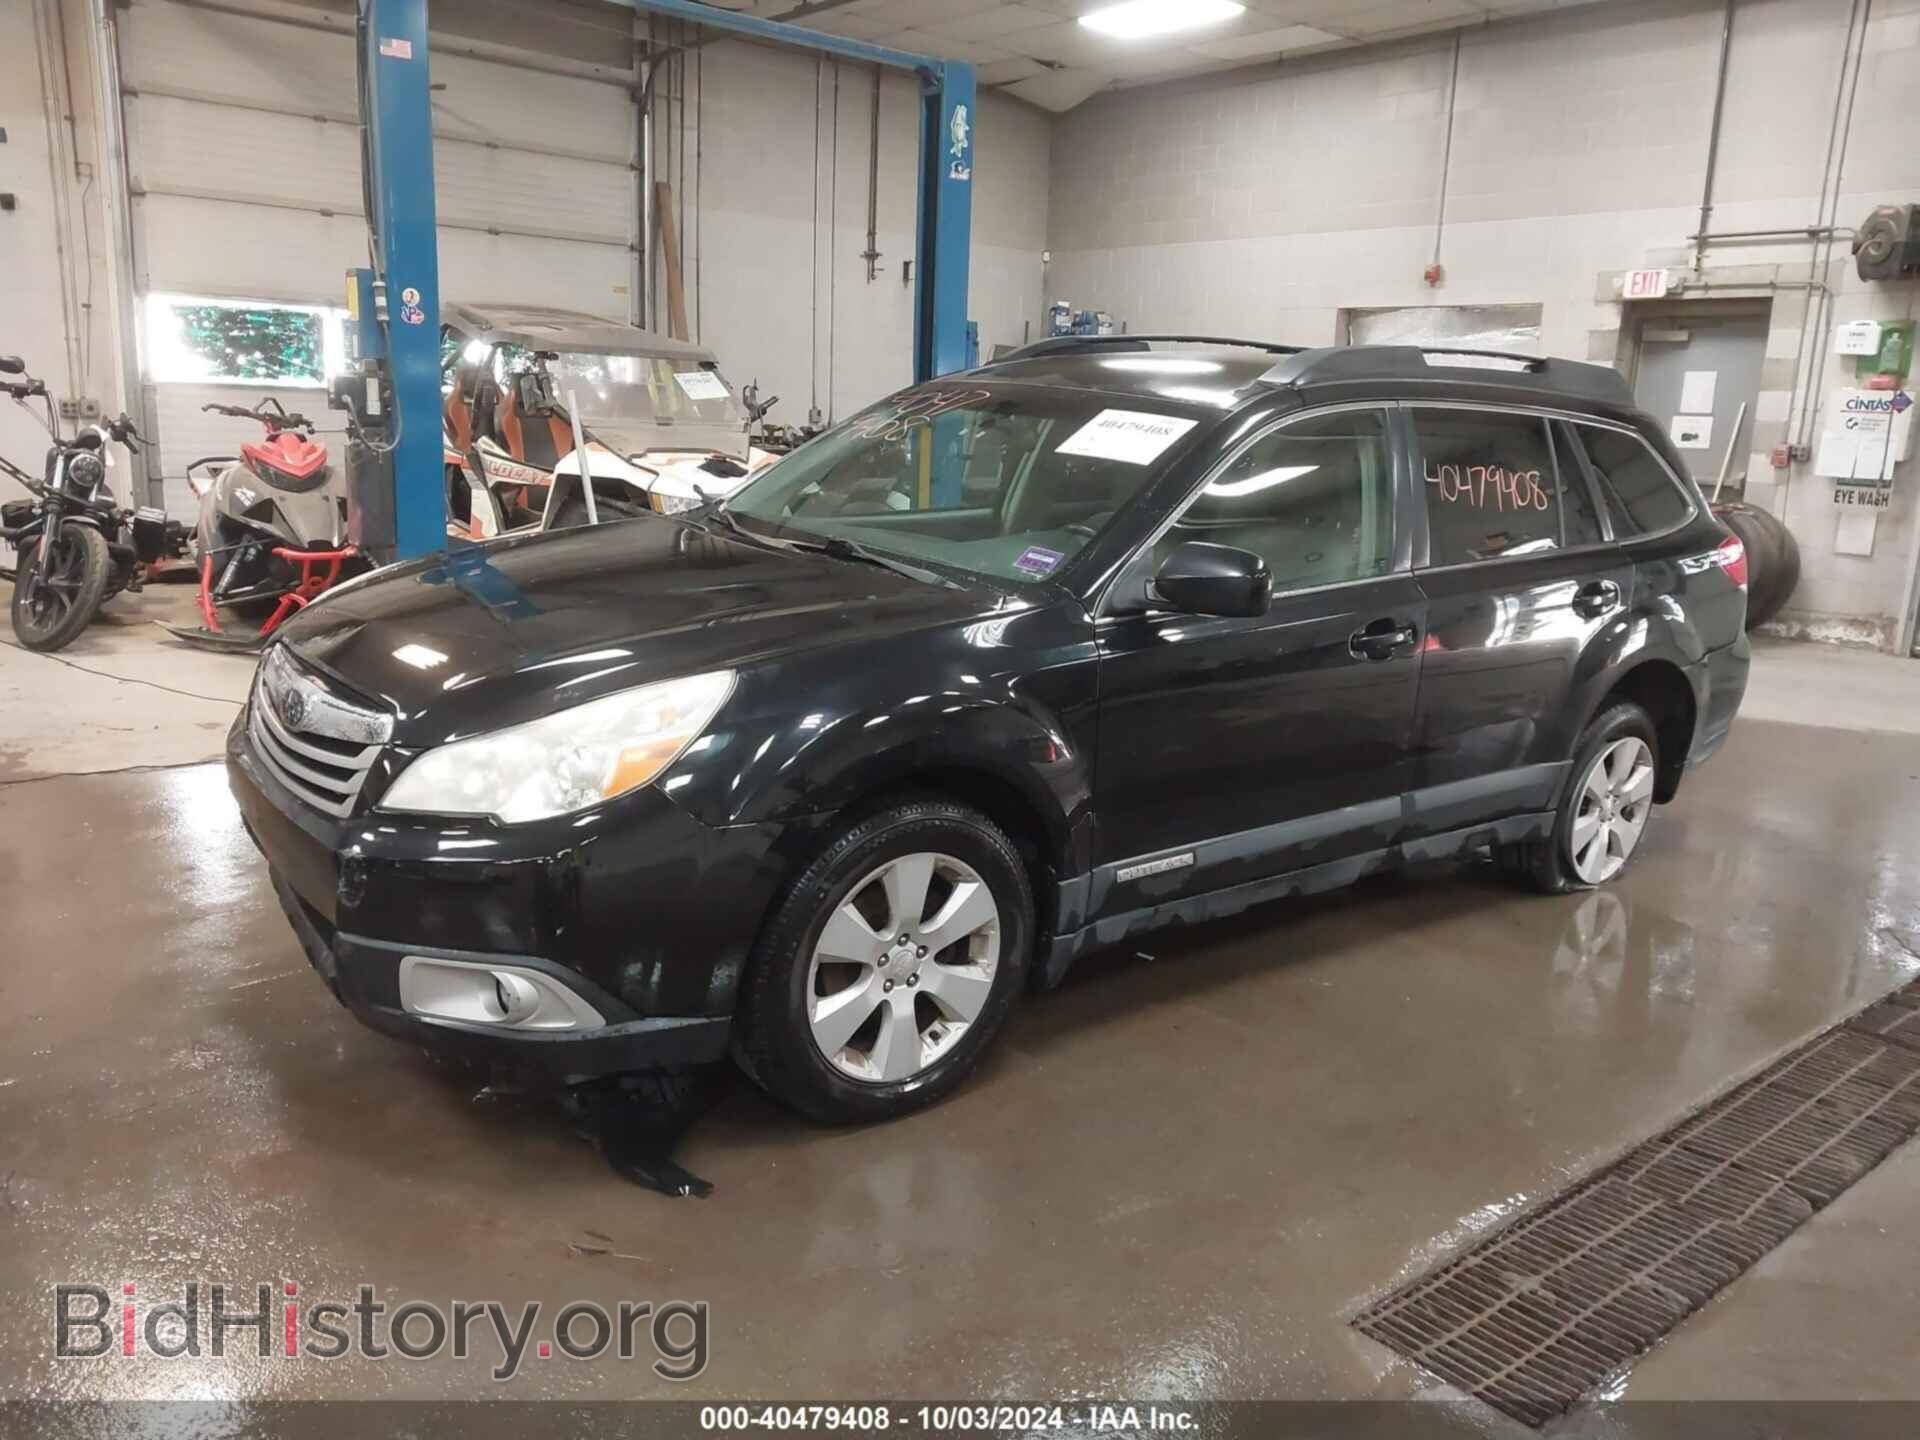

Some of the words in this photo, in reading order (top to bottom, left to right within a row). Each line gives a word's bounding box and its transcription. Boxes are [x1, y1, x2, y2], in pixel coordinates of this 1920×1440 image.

[1631, 271, 1660, 295] EXIT
[1846, 395, 1891, 411] CINTAS
[1423, 457, 1549, 512] 40479408
[1833, 489, 1856, 505] EYE
[1858, 491, 1890, 508] WASH
